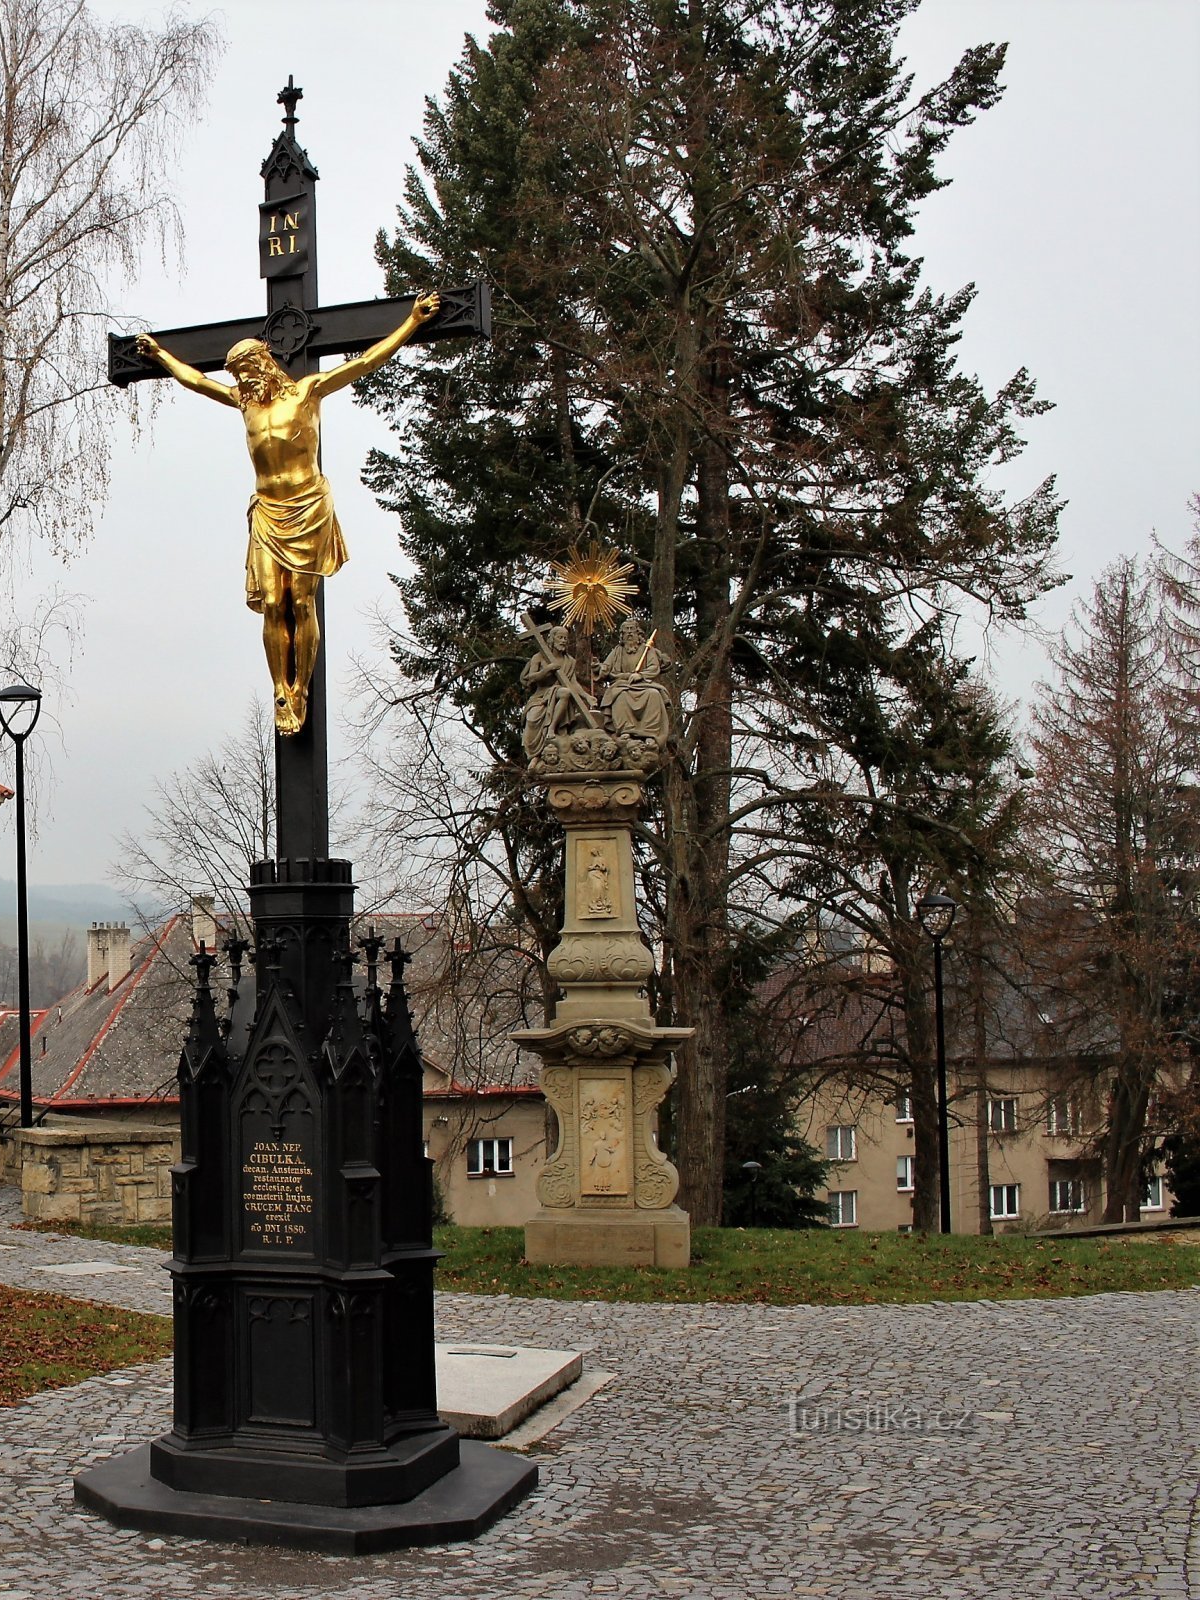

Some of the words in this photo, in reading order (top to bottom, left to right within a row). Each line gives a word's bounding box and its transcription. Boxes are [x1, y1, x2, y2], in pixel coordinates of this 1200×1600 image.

[254, 1142, 280, 1152] JOAN.
[282, 1143, 302, 1152] NEP.
[253, 1174, 302, 1184] restaurator
[294, 1184, 303, 1193] et
[243, 1192, 284, 1201] coemeterii
[244, 1202, 282, 1212] CRUCEM
[285, 1203, 312, 1213] HANC
[265, 1212, 291, 1222] erexit
[264, 1223, 281, 1233] DNI
[284, 1224, 307, 1234] 1880.
[262, 1234, 272, 1244] R.
[275, 1235, 282, 1244] I.
[285, 1235, 294, 1244] P.
